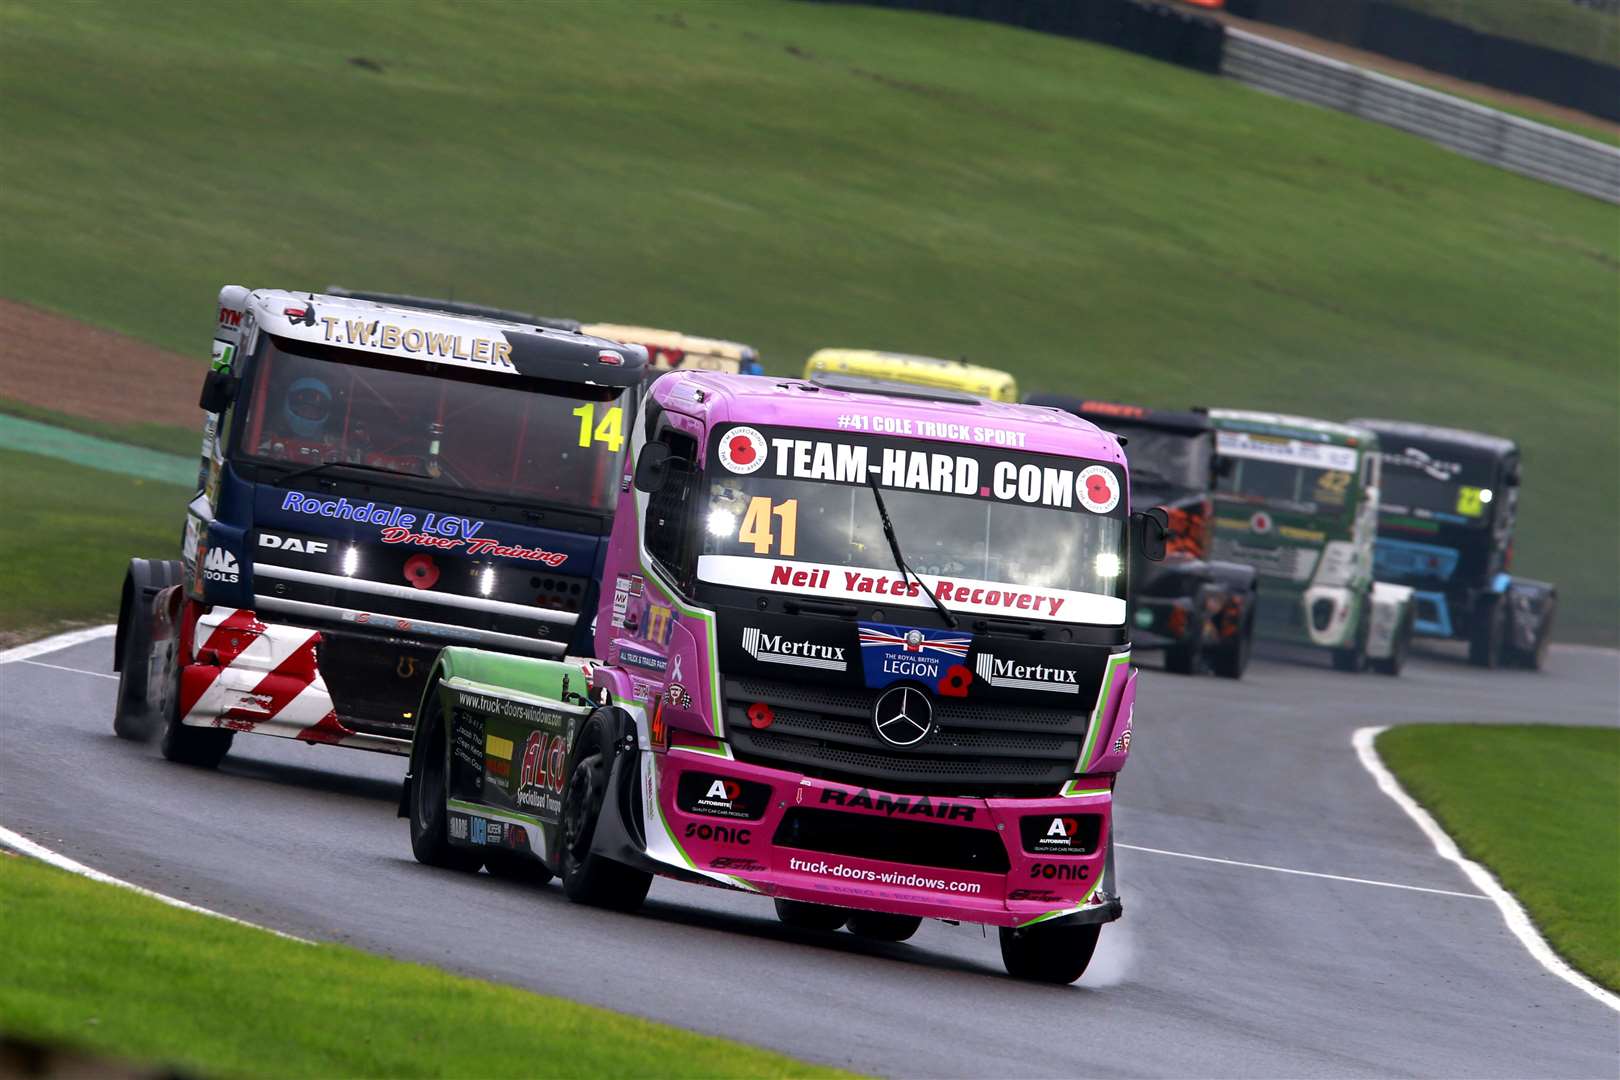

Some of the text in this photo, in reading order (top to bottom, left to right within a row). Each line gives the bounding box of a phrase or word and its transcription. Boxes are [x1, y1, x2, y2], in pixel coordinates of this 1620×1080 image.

[573, 403, 624, 452] 14
[837, 415, 1026, 447] #41 COLE TRUCK SPORT
[772, 438, 1074, 508] TEAM-HARD.COM
[282, 491, 484, 540] Rochdale LGV
[739, 496, 797, 557] 41
[258, 533, 328, 554] DAF
[381, 527, 569, 567] Driver Training
[770, 565, 1065, 617] Neil Yates Recovery
[759, 633, 846, 661] Mertrux
[897, 654, 917, 662] ROYAL
[917, 656, 940, 665] BRITISH
[883, 660, 939, 678] LEGION
[992, 658, 1077, 684] Mertrux
[697, 799, 731, 808] AUTOBRITE
[819, 788, 977, 822] RAMAIR
[789, 857, 982, 894] truck-doors-windows.com
